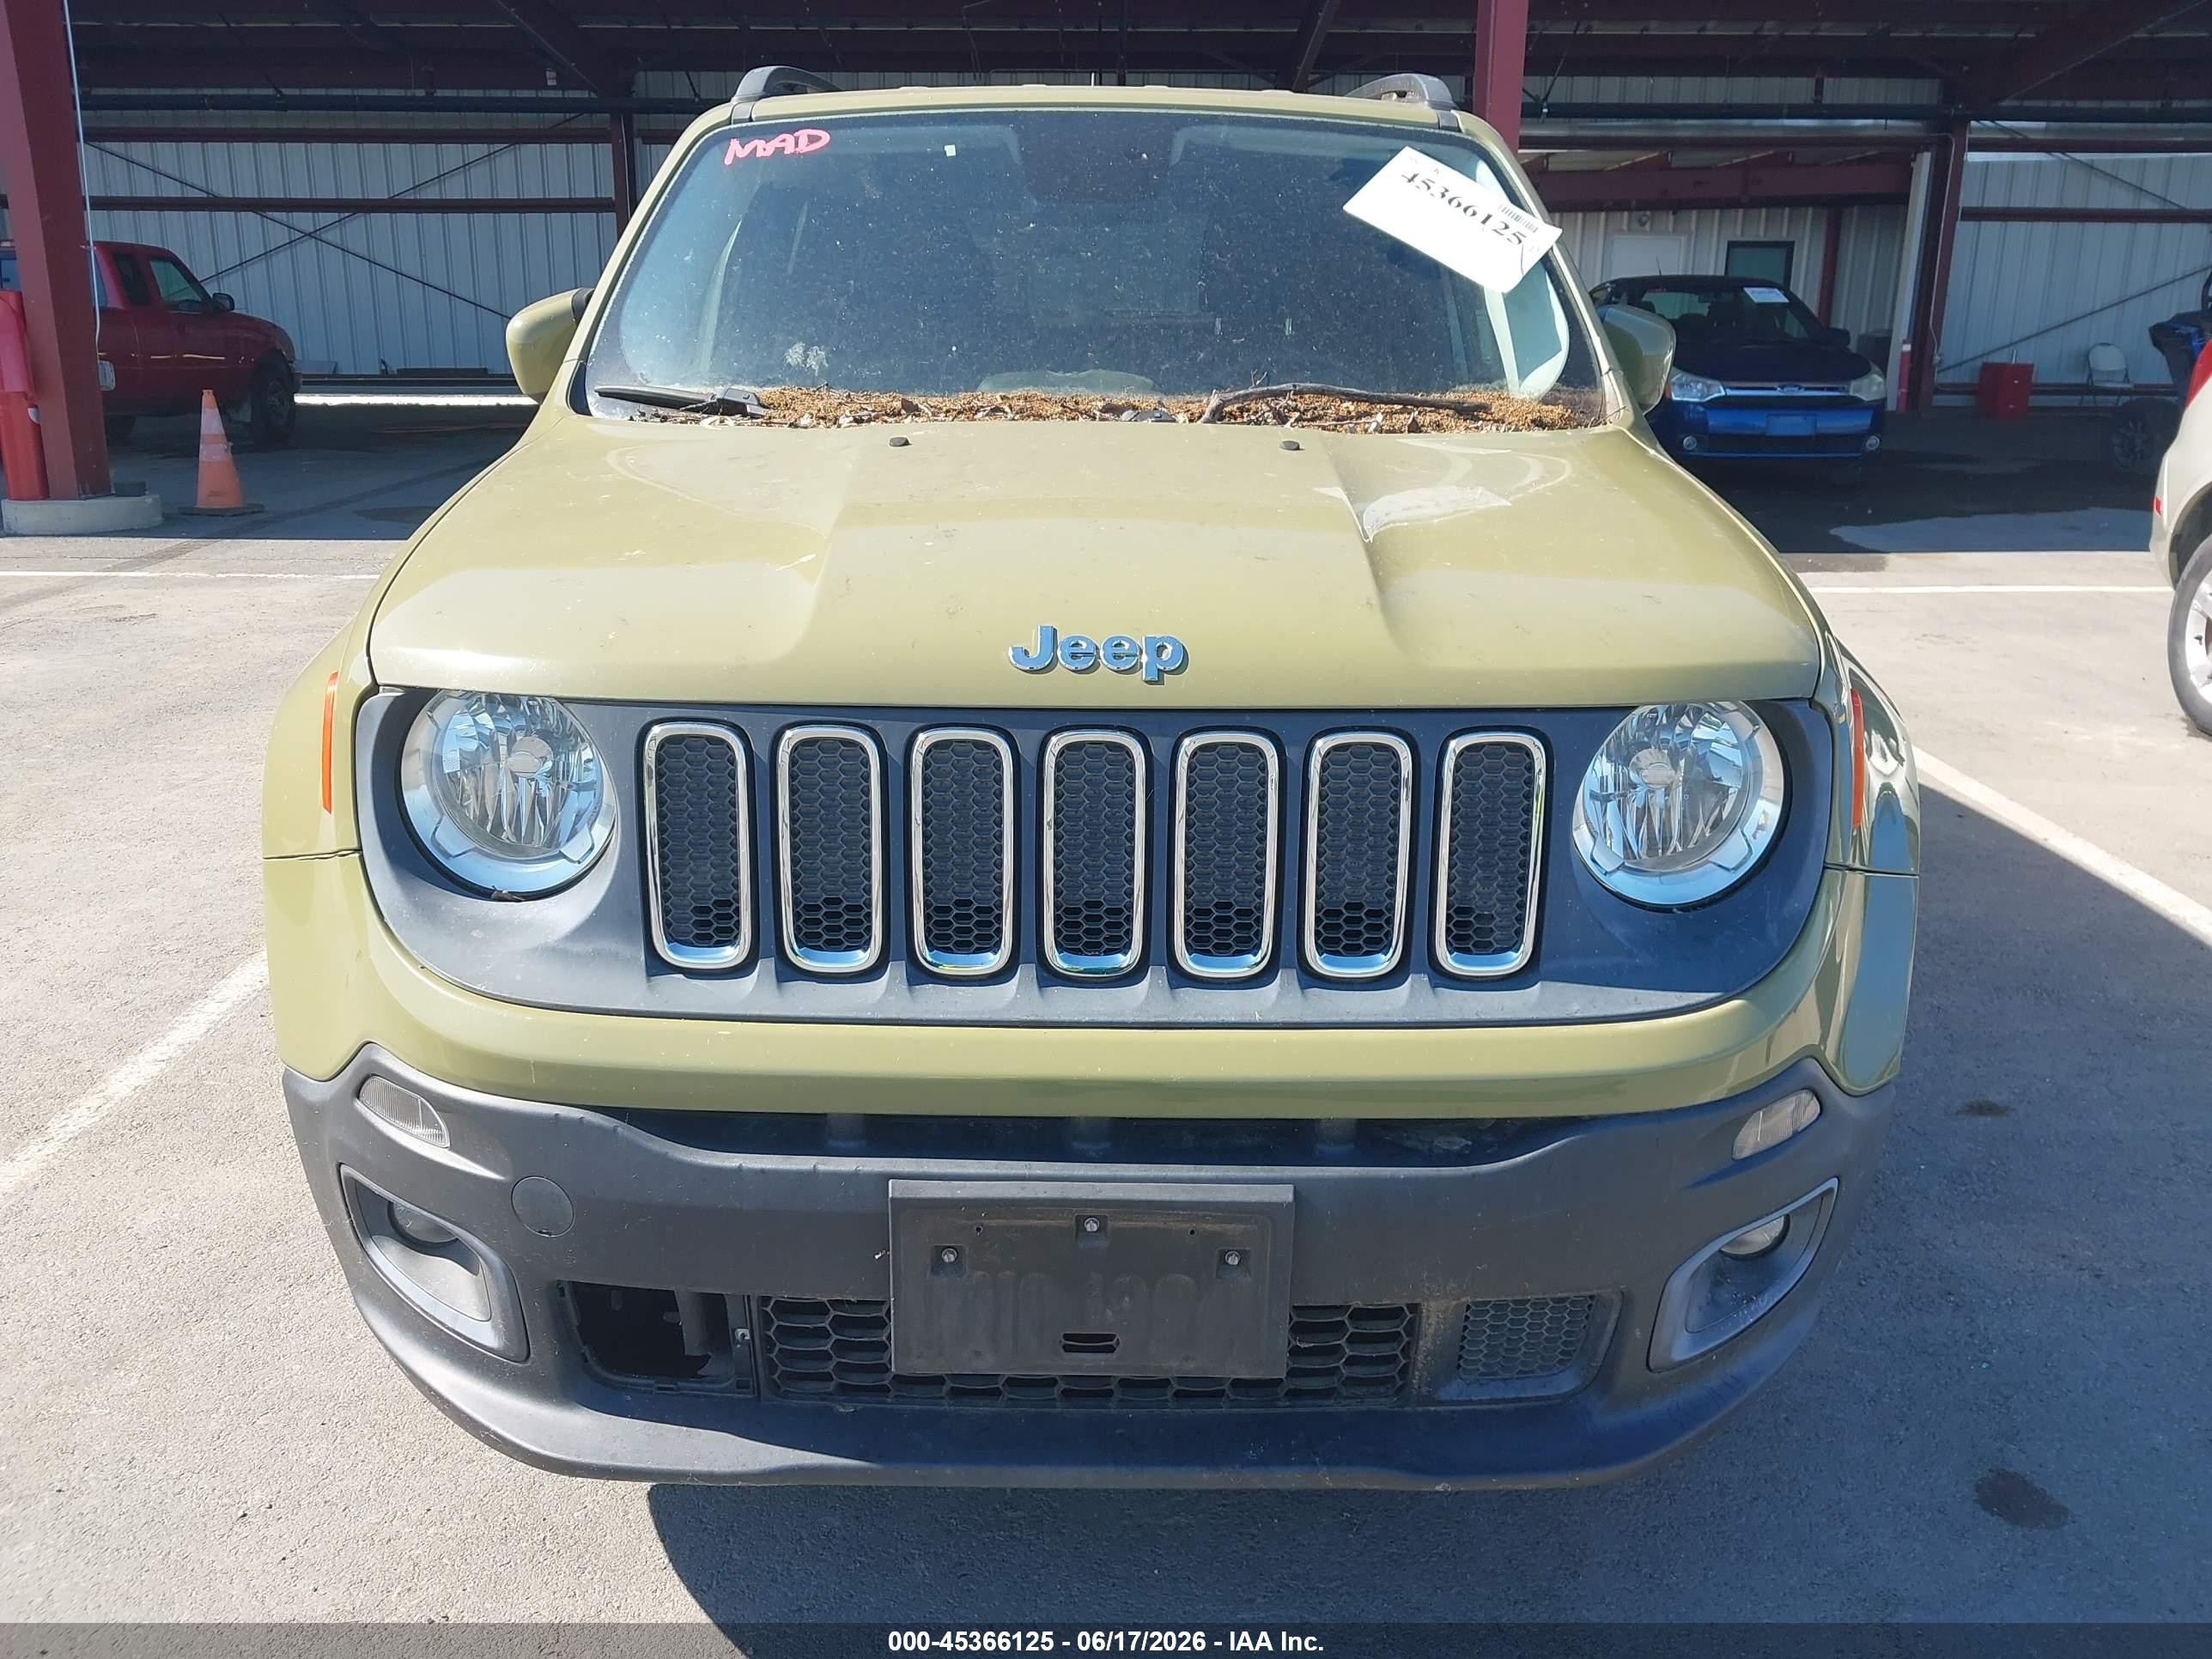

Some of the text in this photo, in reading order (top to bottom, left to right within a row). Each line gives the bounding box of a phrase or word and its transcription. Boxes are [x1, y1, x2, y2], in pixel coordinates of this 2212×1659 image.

[724, 128, 830, 166] MAD
[1401, 172, 1528, 246] 45366125
[1008, 624, 1187, 684] Jeep
